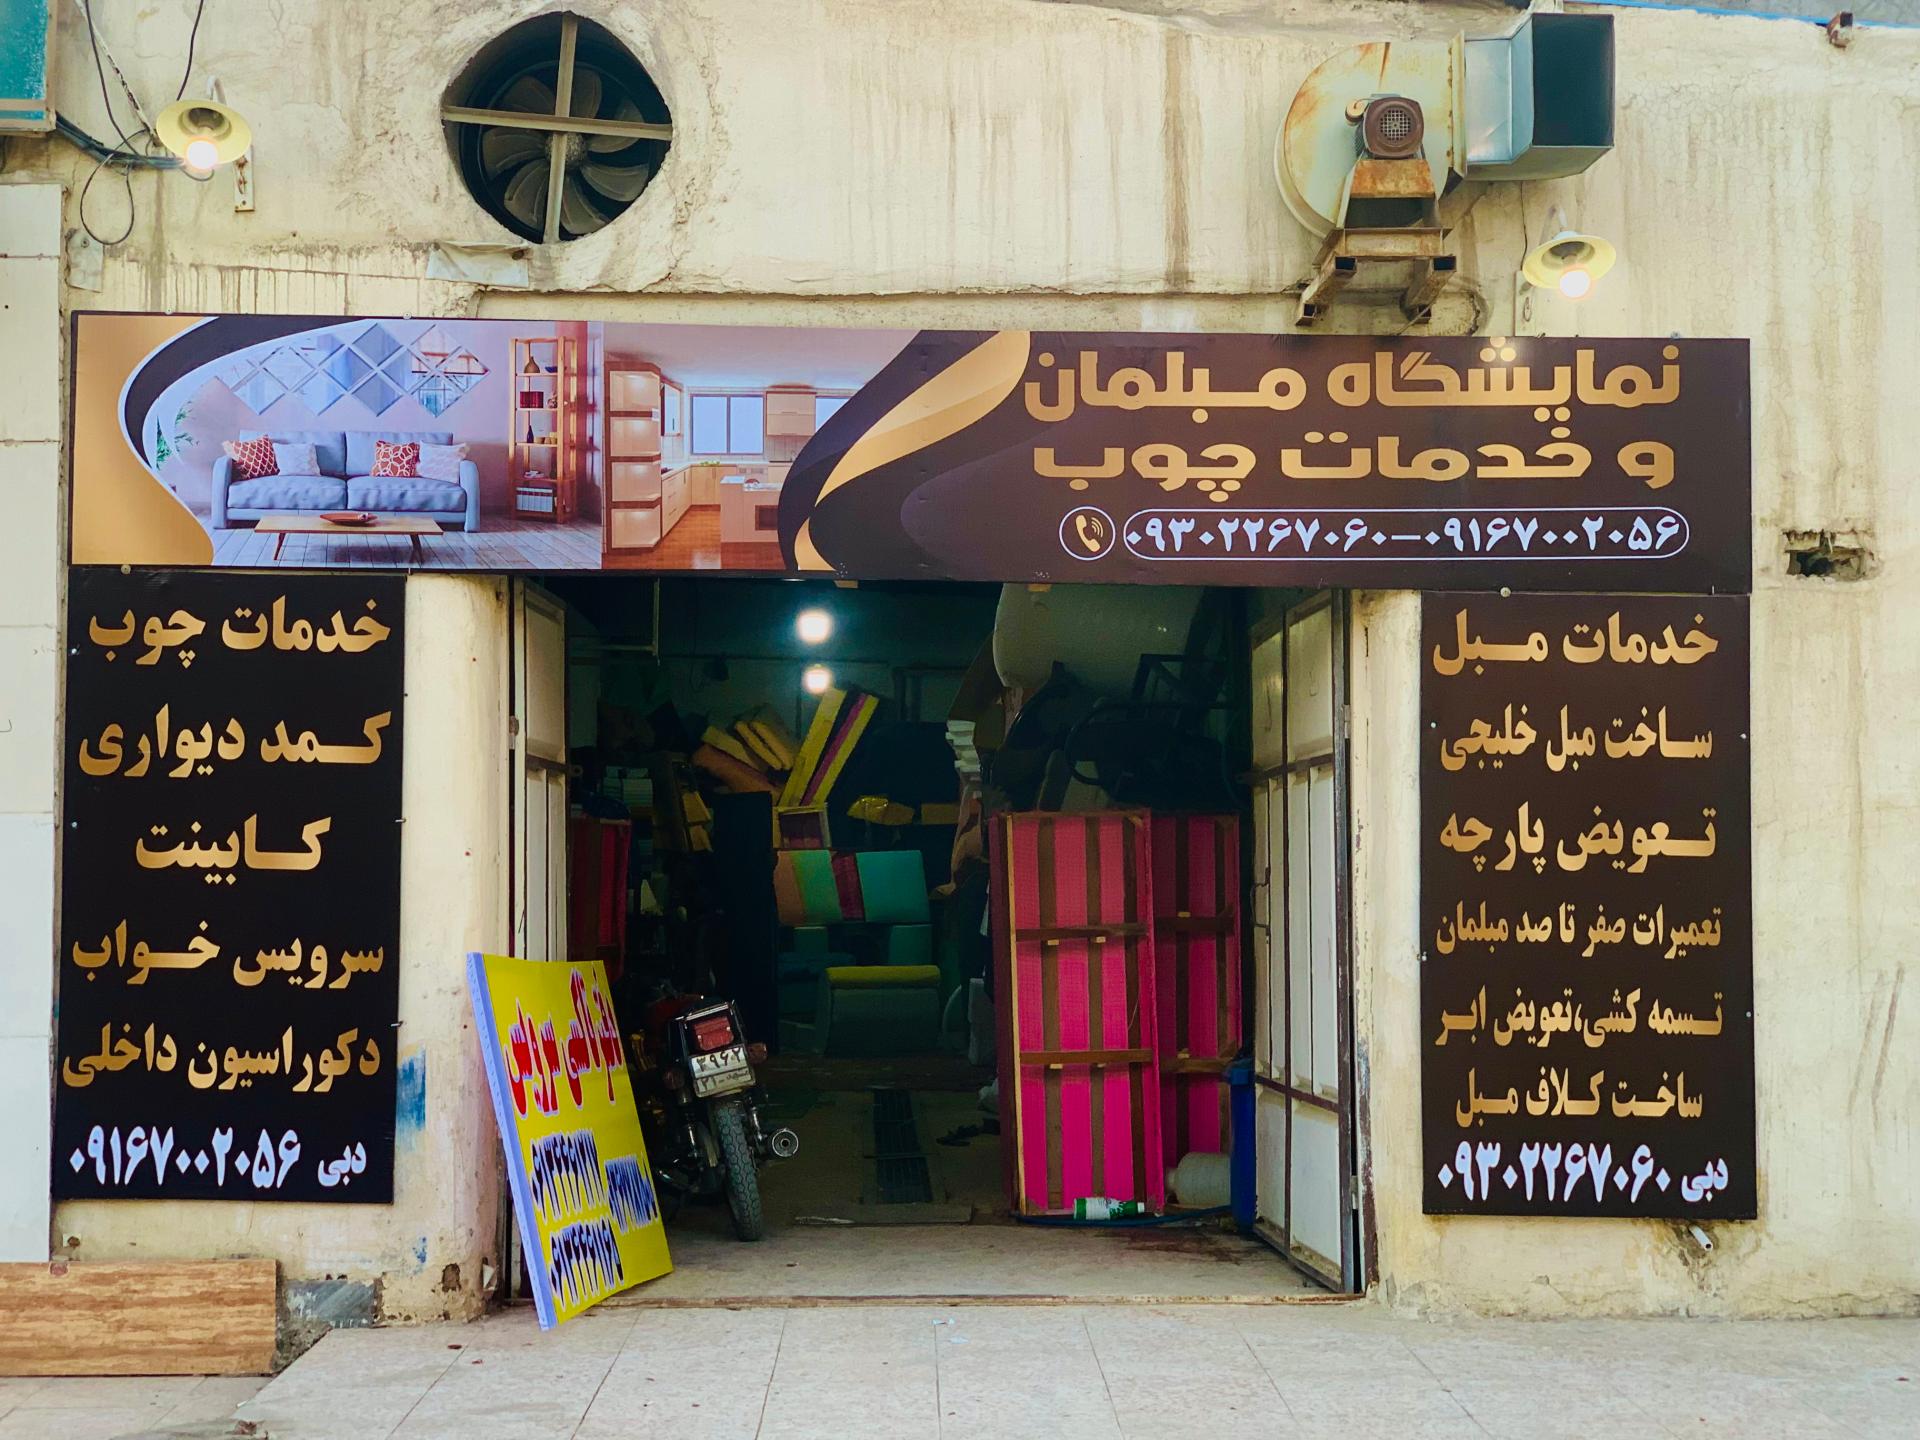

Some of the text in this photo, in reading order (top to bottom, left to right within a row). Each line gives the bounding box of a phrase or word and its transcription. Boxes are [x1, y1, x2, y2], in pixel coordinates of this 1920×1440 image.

[1023, 336, 1679, 423] نمایشگاه مبلمان
[1034, 427, 1674, 502] و خدمات چوب
[90, 597, 390, 667] خدمات چوب
[1433, 609, 1718, 675] خدمات مبل
[80, 705, 390, 777] کمد دیواری
[1441, 704, 1712, 771] ساخت مبل خلیجی
[136, 815, 331, 884] کابینت
[1441, 802, 1716, 874] تعویض پارچه
[73, 921, 383, 988] سرویس خواب
[1437, 901, 1508, 954] مبلمان
[1582, 906, 1625, 957] صفر
[1633, 905, 1720, 959] تعمیرات
[1436, 987, 1485, 1045] ابر
[1648, 993, 1722, 1035] تسمه
[63, 1024, 379, 1092] دکوراسیون داخلی
[1457, 1068, 1702, 1127] ساخت کلاف مبل
[70, 1126, 300, 1188] ۰۹۱۶۷۰۰۲۰۵۶
[1438, 1141, 1670, 1202] ۰۹۳۰۲۲۶۷۰۶۰
